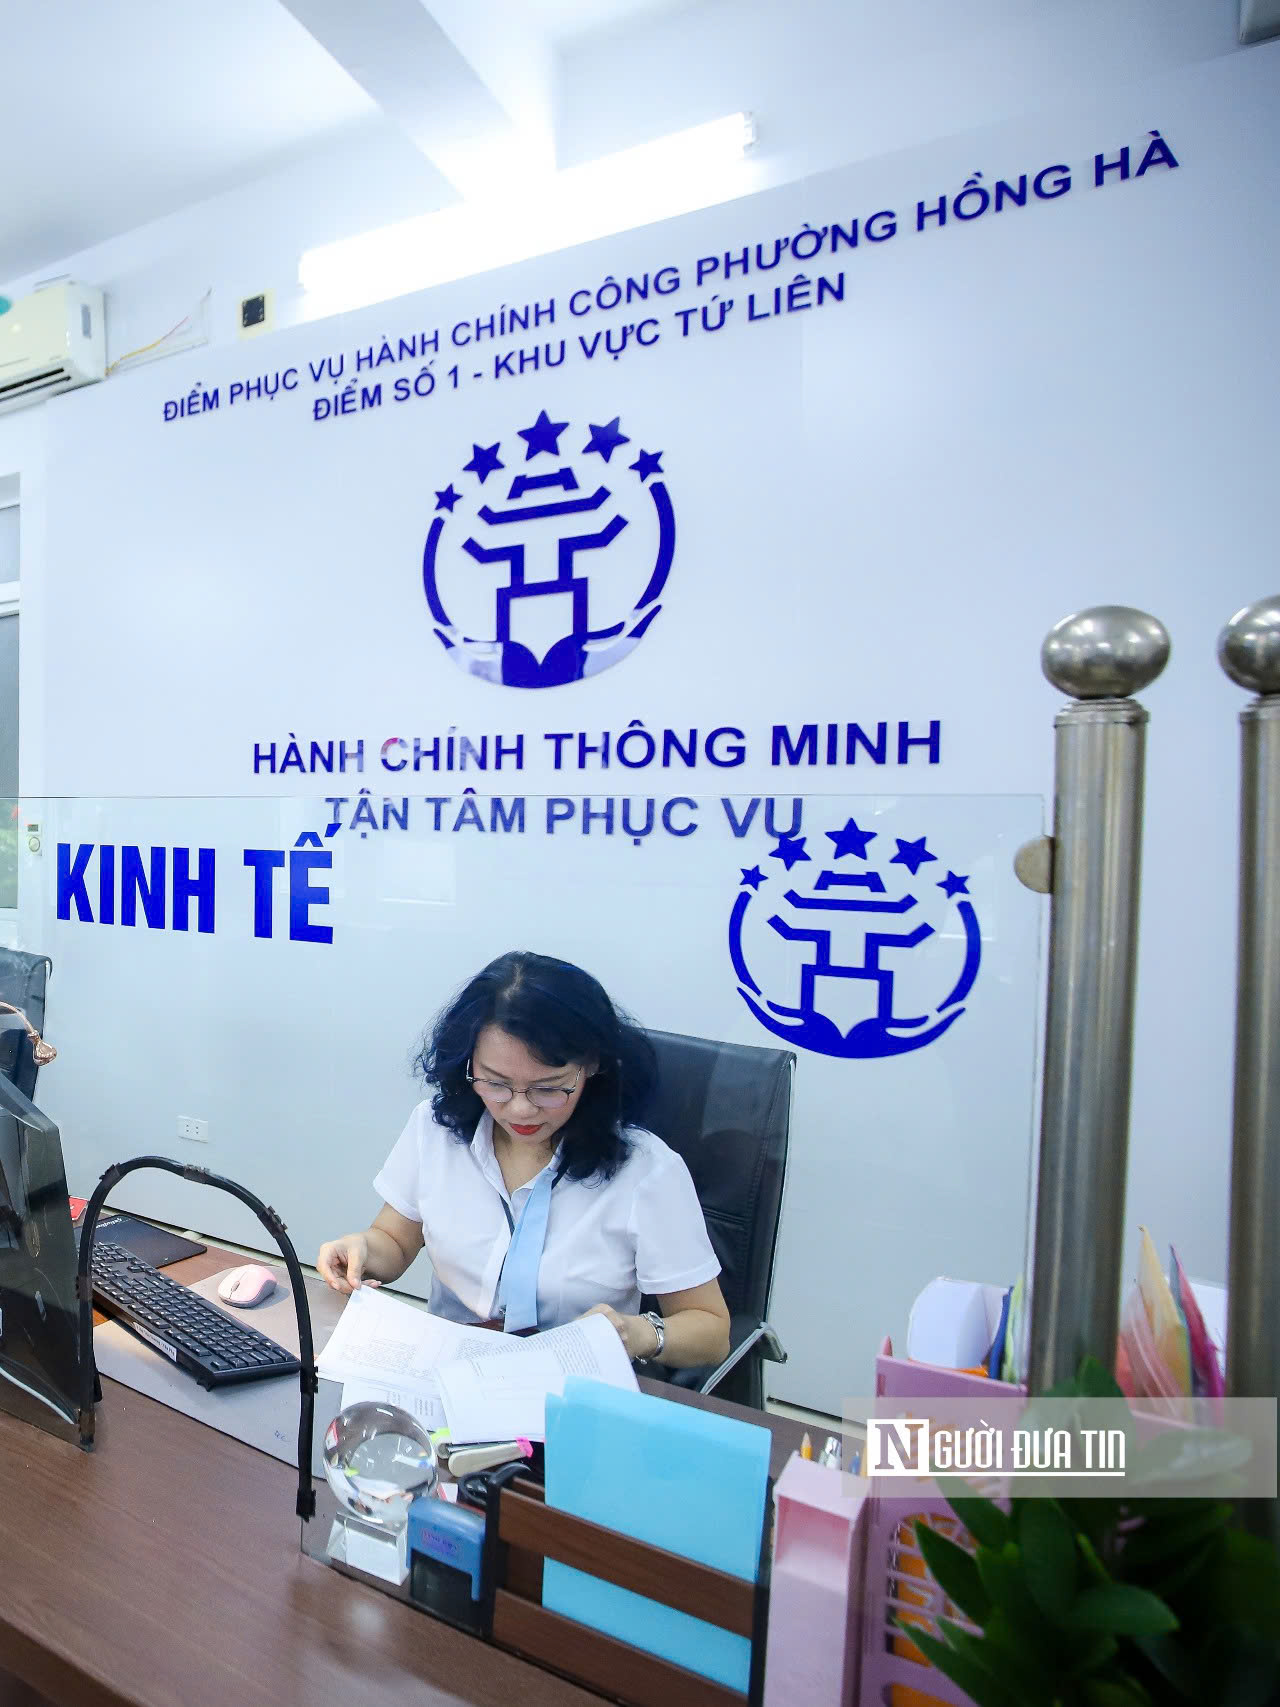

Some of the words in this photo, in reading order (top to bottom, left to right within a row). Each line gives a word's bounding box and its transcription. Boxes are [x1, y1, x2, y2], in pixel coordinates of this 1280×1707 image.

[163, 382, 220, 422] ĐIỂM
[229, 367, 299, 403] PHỤC
[308, 355, 345, 385] VỤ
[356, 330, 440, 372] HÀNH
[451, 299, 556, 346] CHÍNH
[568, 267, 681, 316] CÔNG
[696, 210, 898, 286] PHƯỜNG
[916, 164, 1073, 232] HỒNG
[1094, 129, 1181, 188] HÀ
[312, 378, 382, 421] ĐIỂM
[393, 363, 436, 402] SỐ
[447, 364, 459, 389] 1
[494, 340, 566, 379] KHU
[578, 318, 661, 360] VỰC
[674, 294, 735, 337] TỨ
[747, 272, 846, 321] LIÊN
[253, 733, 364, 773] HÀNH
[381, 726, 525, 772] CHÍNH
[544, 720, 747, 771] THÔNG
[771, 720, 942, 767] MINH
[324, 788, 409, 839] TẬN
[425, 788, 526, 833] TÂM
[546, 796, 699, 847] PHỤC
[56, 843, 216, 935] KINH
[243, 823, 343, 945] TẾ
